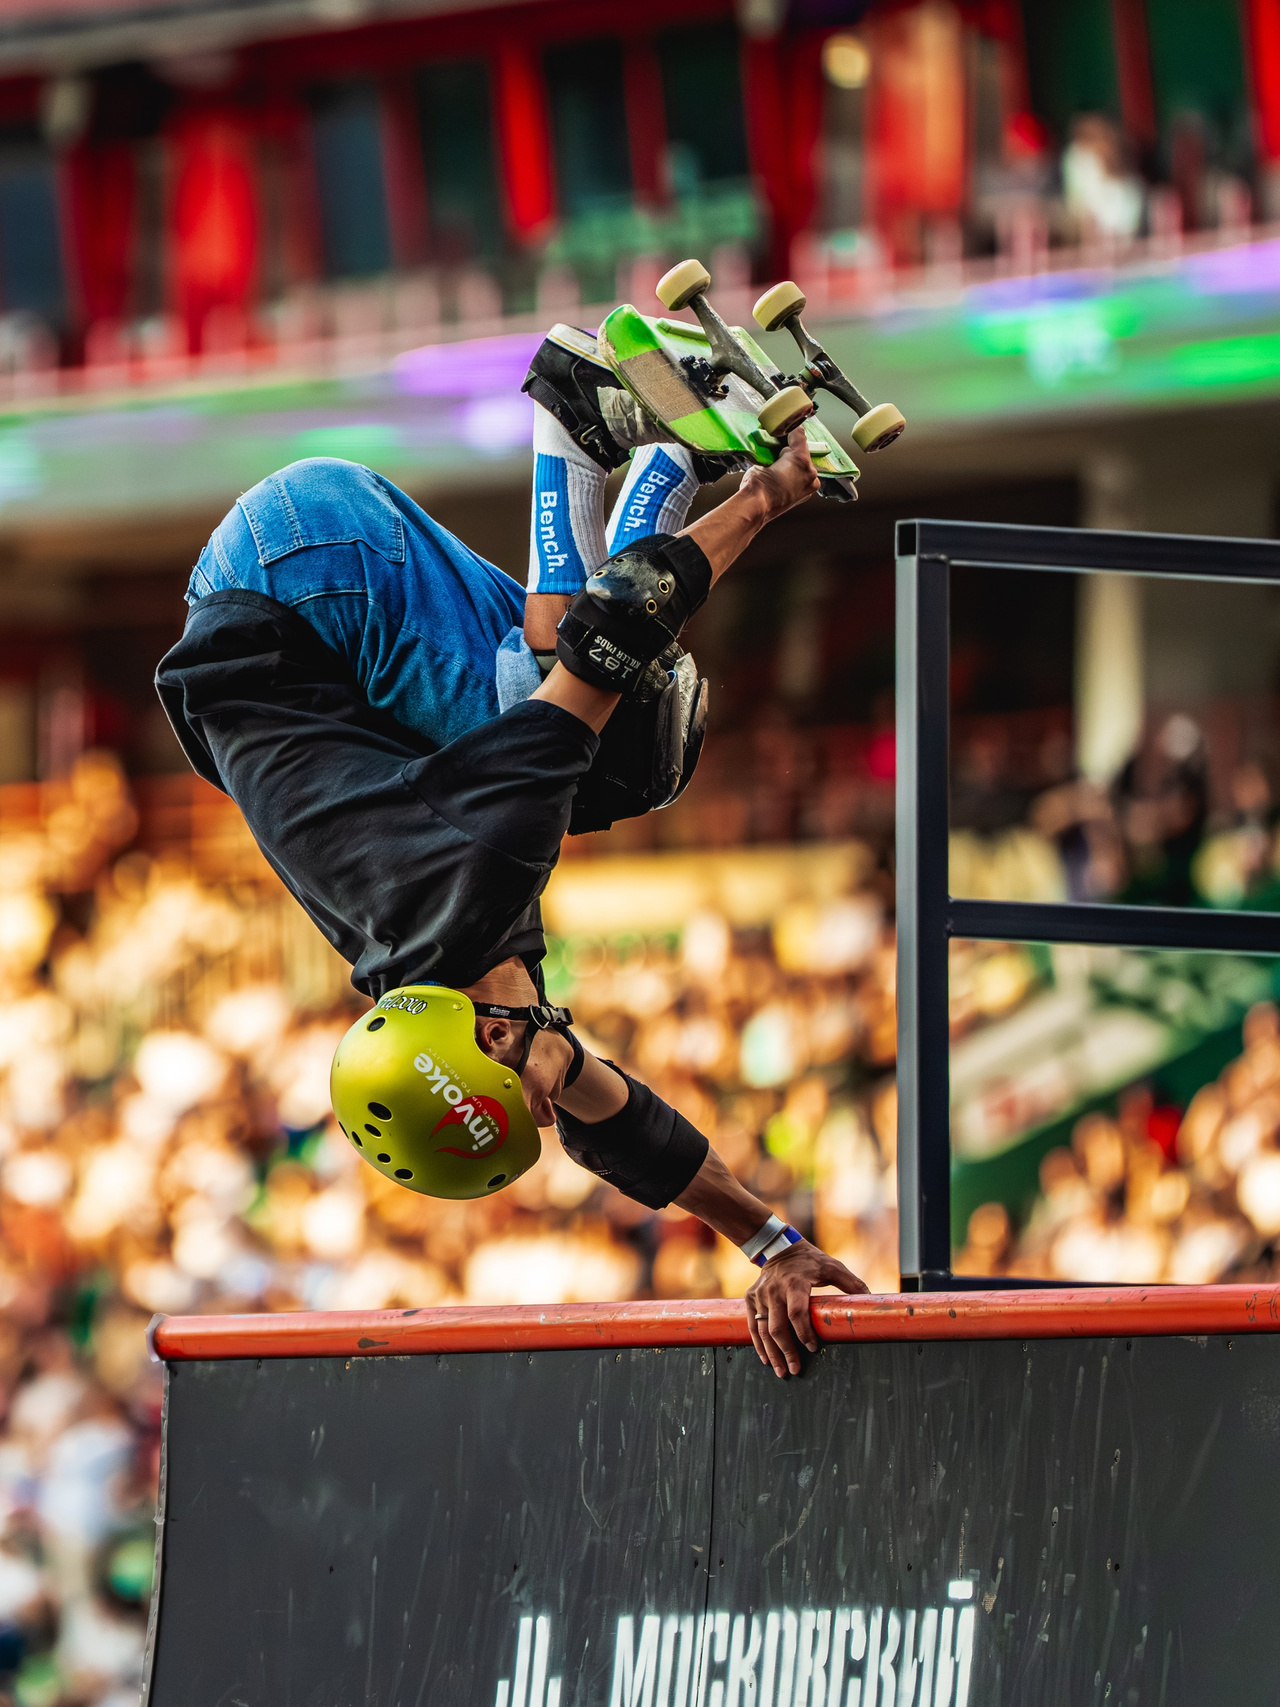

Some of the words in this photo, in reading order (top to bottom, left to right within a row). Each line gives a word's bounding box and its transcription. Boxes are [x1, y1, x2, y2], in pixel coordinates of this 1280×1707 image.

[623, 470, 670, 533] Bench.
[539, 490, 567, 574] Bench.
[594, 635, 617, 654] PADS
[588, 647, 633, 679] 187
[616, 650, 642, 669] KILLER
[426, 1047, 461, 1080] REALITY
[413, 1052, 494, 1151] invoke
[461, 1081, 471, 1094] TO
[472, 1096, 483, 1108] UP
[482, 1108, 500, 1135] WAKE
